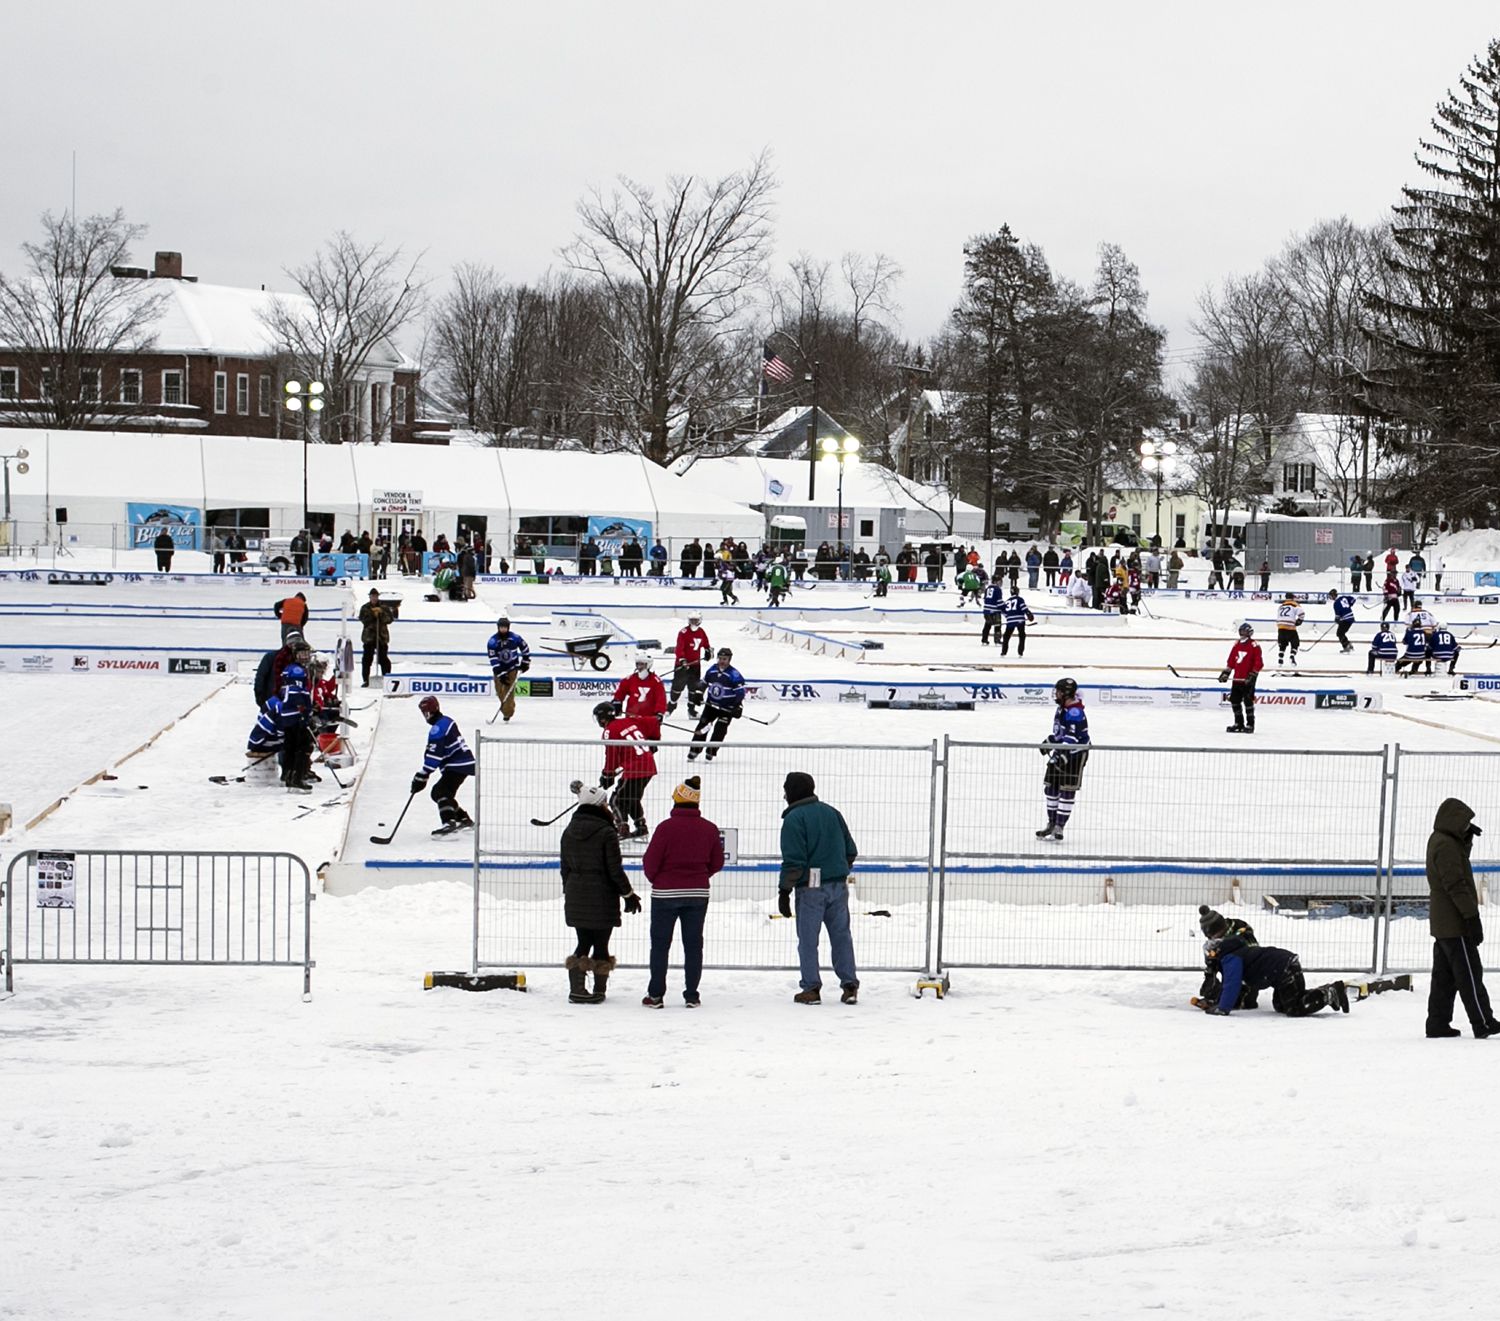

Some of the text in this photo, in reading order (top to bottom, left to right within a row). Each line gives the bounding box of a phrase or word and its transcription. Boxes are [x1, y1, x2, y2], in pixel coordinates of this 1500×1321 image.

[1005, 600, 1018, 612] 37
[1413, 633, 1426, 646] 21
[1438, 633, 1451, 645] 18
[97, 660, 160, 670] SYLVANIA
[391, 681, 400, 692] 7
[412, 681, 488, 694] BUD LIGHT
[558, 681, 612, 691] BODYARMOR
[781, 684, 816, 698] TSR
[1460, 680, 1469, 691] 6
[1477, 680, 1500, 690] BUD
[888, 688, 897, 700] 7
[970, 686, 1002, 700] TSR
[1363, 697, 1373, 709] 7
